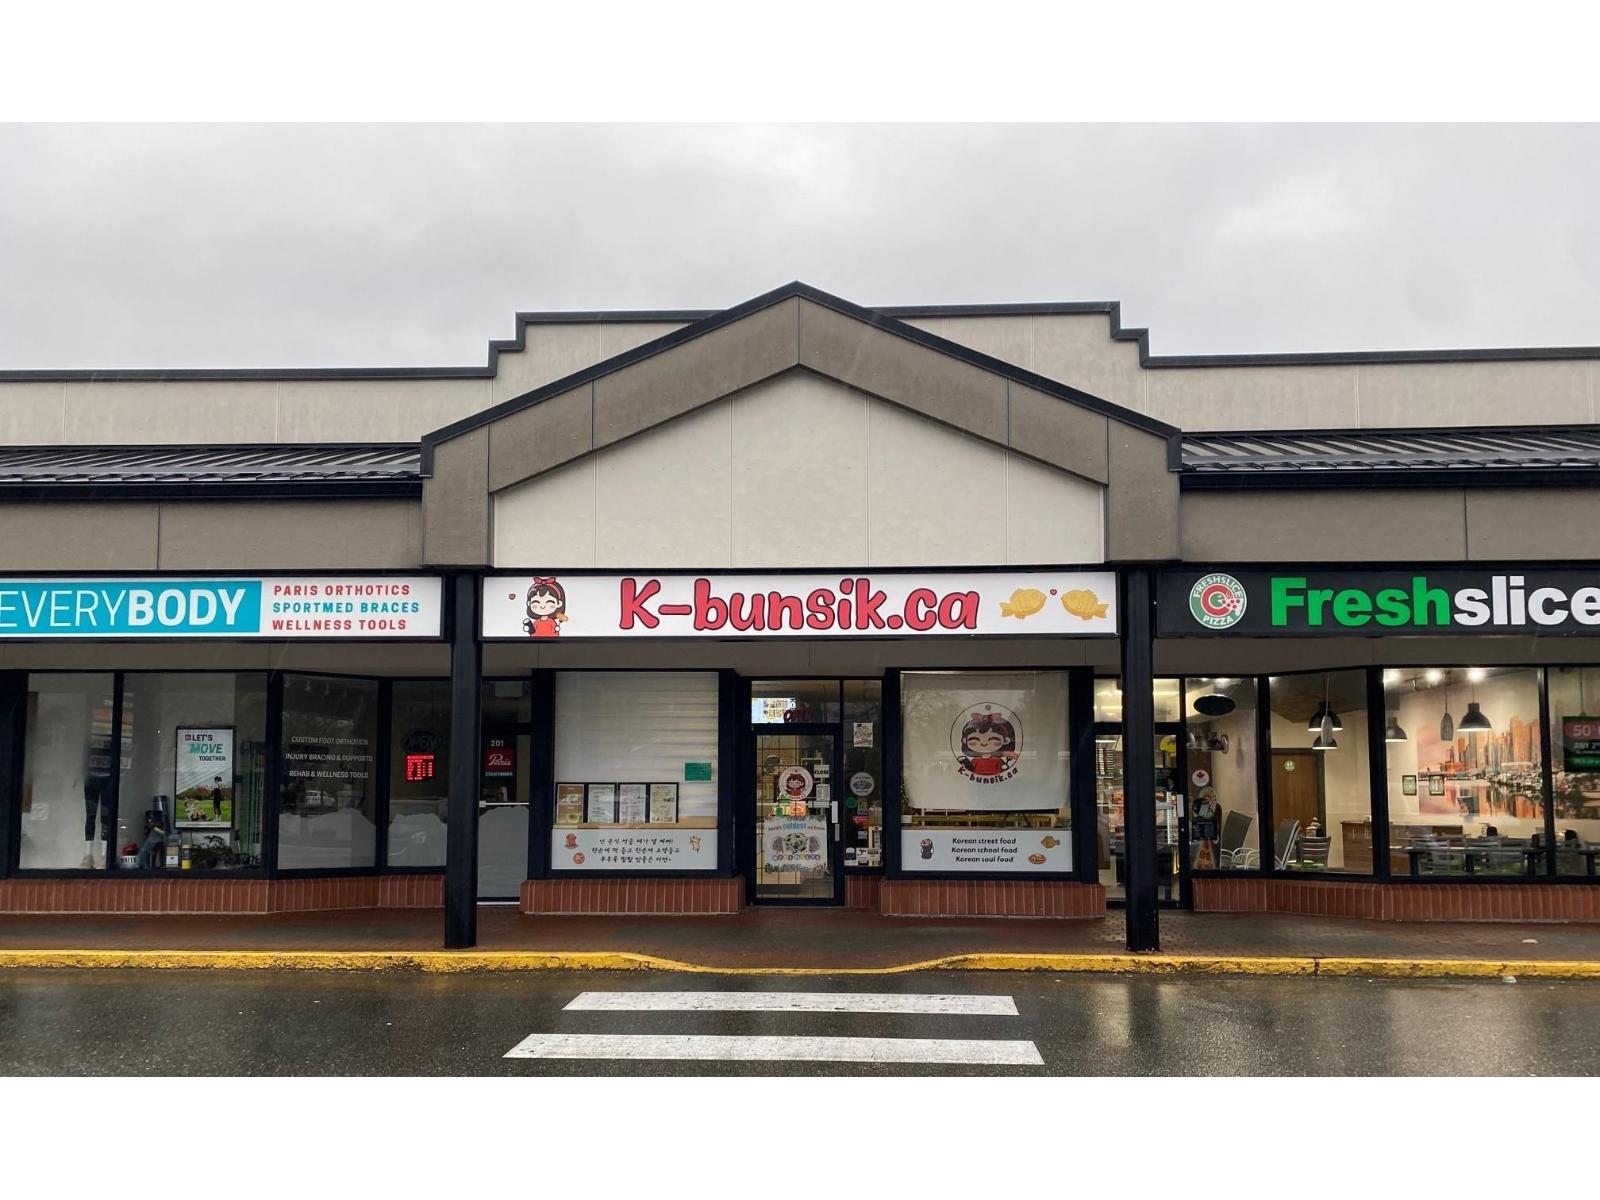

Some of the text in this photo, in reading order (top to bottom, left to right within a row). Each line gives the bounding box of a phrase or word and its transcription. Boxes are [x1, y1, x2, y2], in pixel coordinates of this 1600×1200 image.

[273, 585, 410, 596] PARIS ORTHOTICS
[1193, 576, 1243, 598] FRESHSLICE
[619, 578, 980, 631] K-bunsik.ca
[1271, 576, 1600, 626] Freshslice
[0, 588, 246, 628] EVERYBODY
[273, 602, 419, 613] SPORTMED BRACES
[272, 619, 407, 630] WELLNESS TOOLS
[1203, 615, 1234, 625] PIZZA
[192, 734, 213, 742] LET'S
[188, 743, 223, 754] MOVE
[286, 753, 308, 761] INJURY
